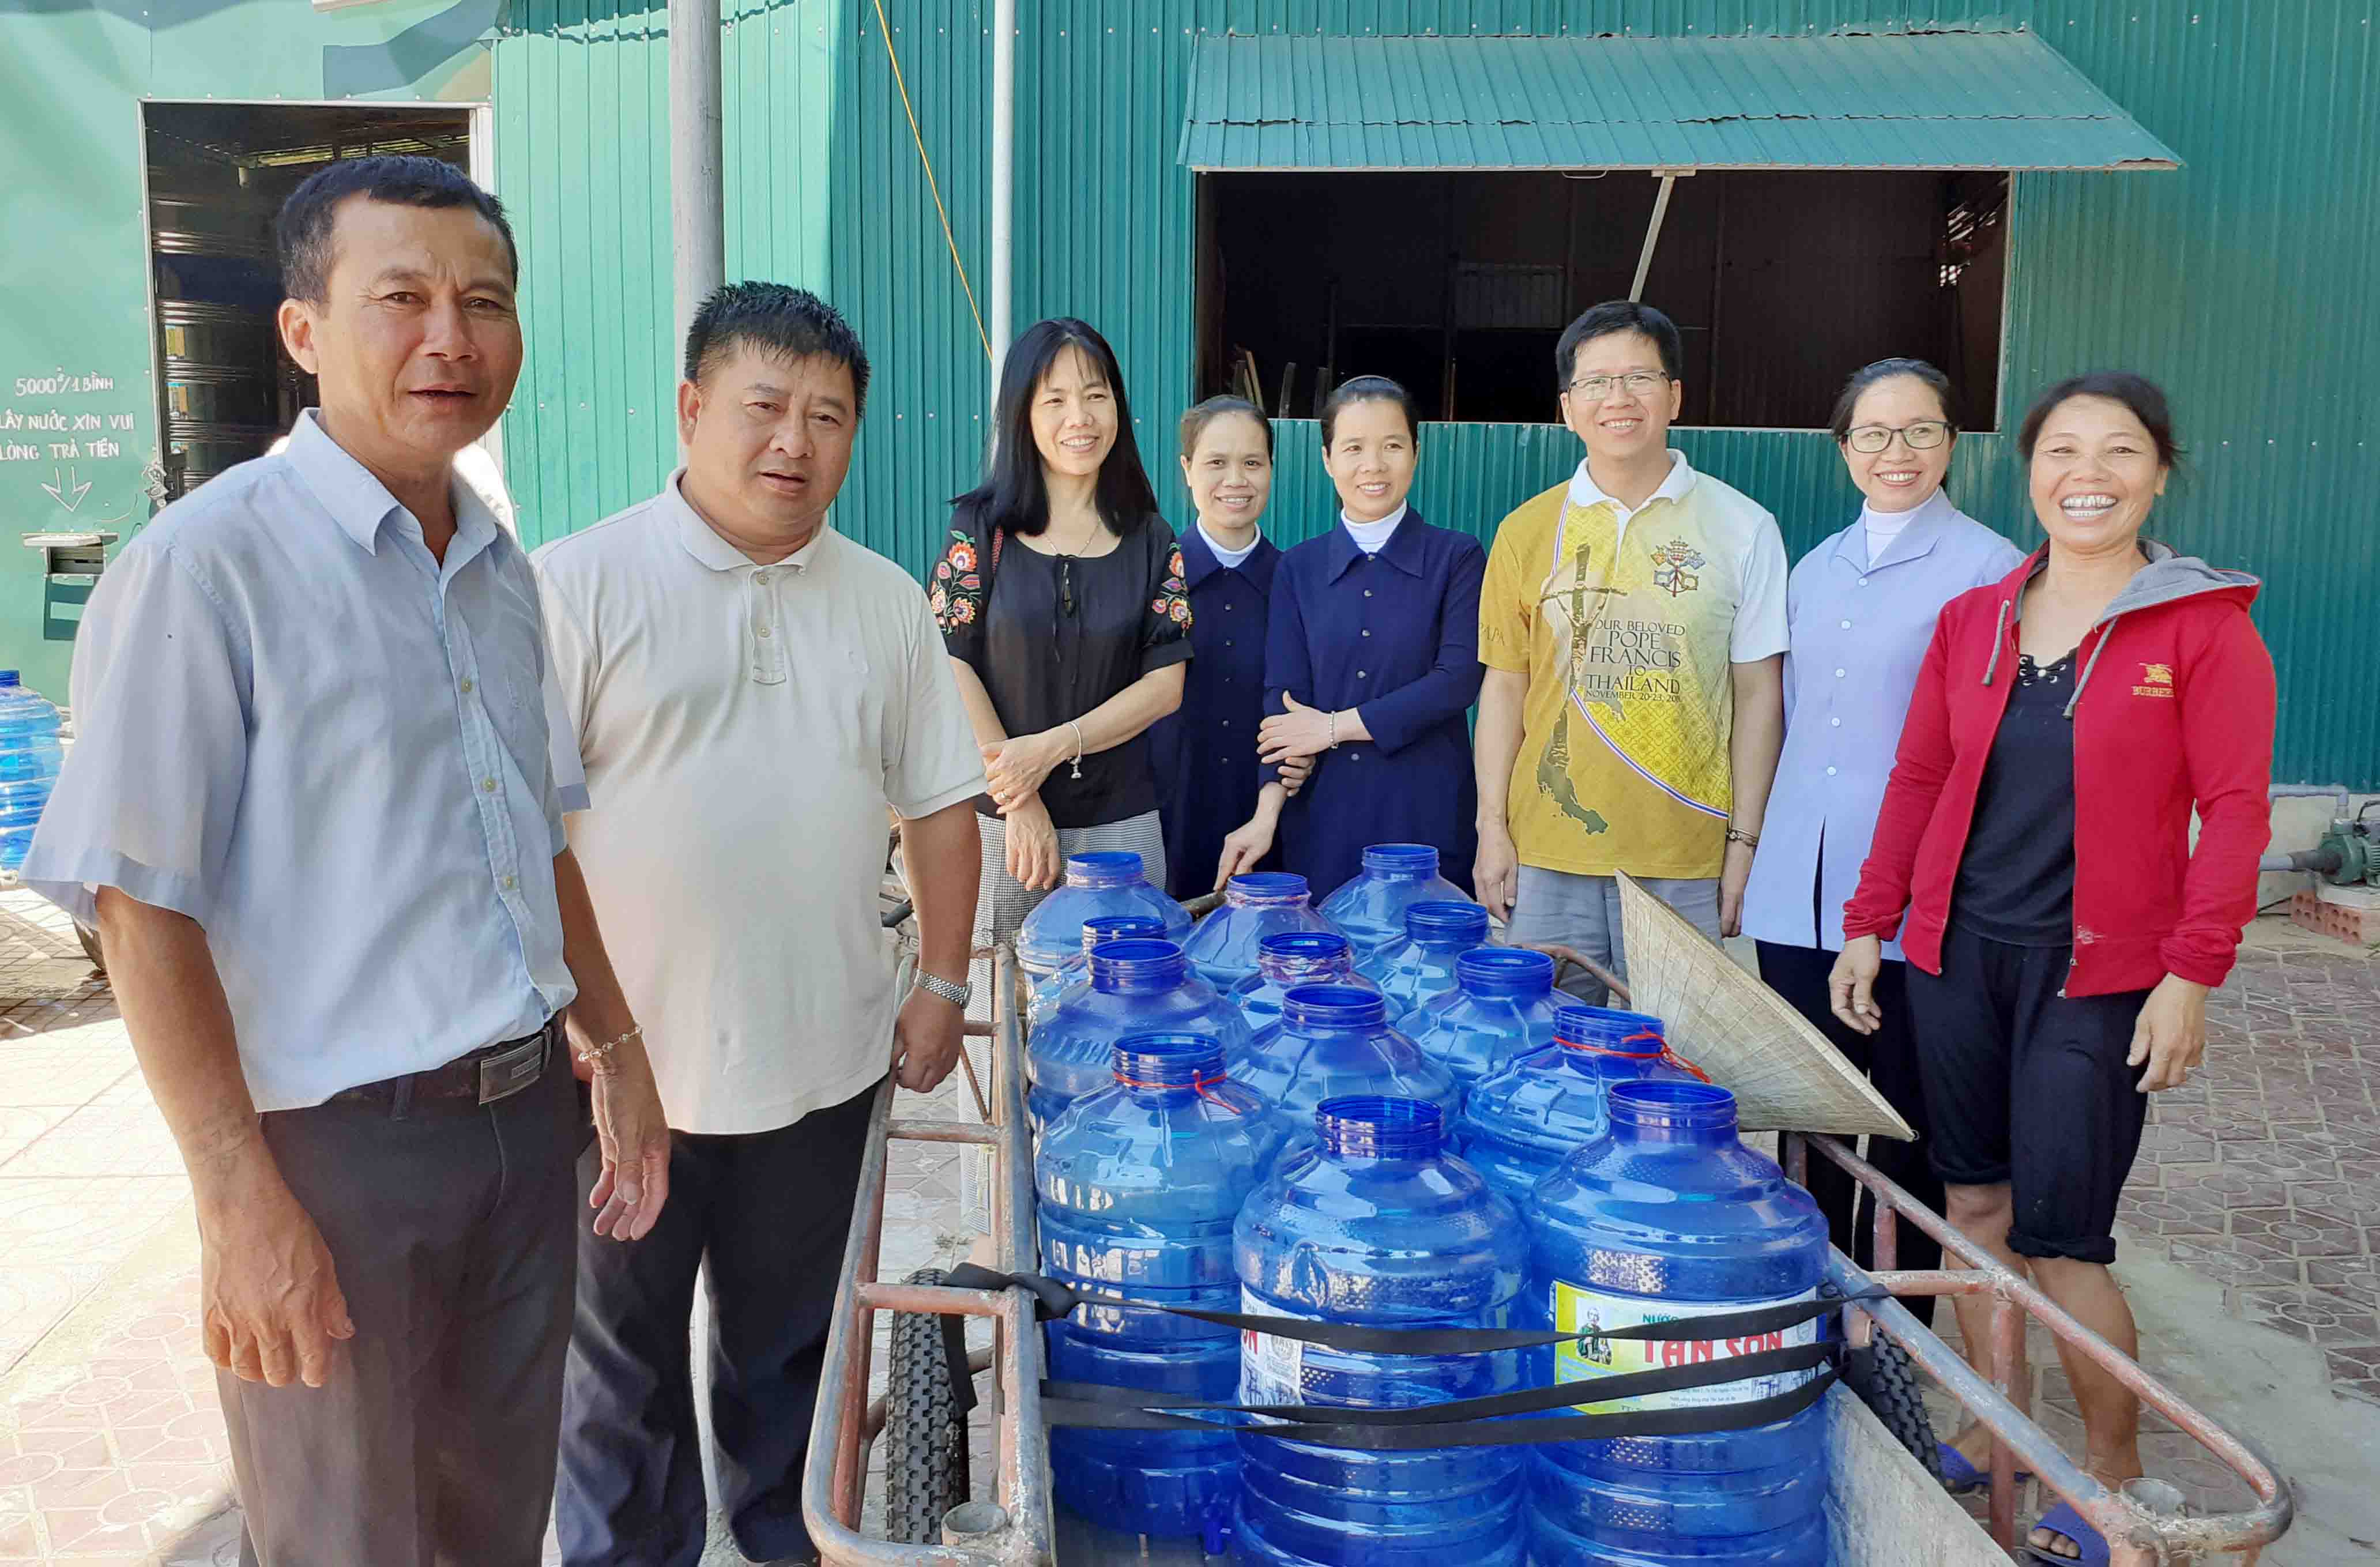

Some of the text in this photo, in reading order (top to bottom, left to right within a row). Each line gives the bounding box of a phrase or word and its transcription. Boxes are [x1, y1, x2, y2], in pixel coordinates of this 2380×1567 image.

[72, 413, 101, 430] XIN
[108, 413, 134, 430] VUI
[0, 439, 40, 460] LÒNG
[1595, 619, 1685, 636] OUR BELOVED
[1609, 631, 1661, 650] POPE
[1590, 646, 1681, 668] FRANCIS
[1626, 664, 1646, 676] TO
[1586, 674, 1680, 694] THAILAND
[1586, 691, 1637, 700] NOVEMBER
